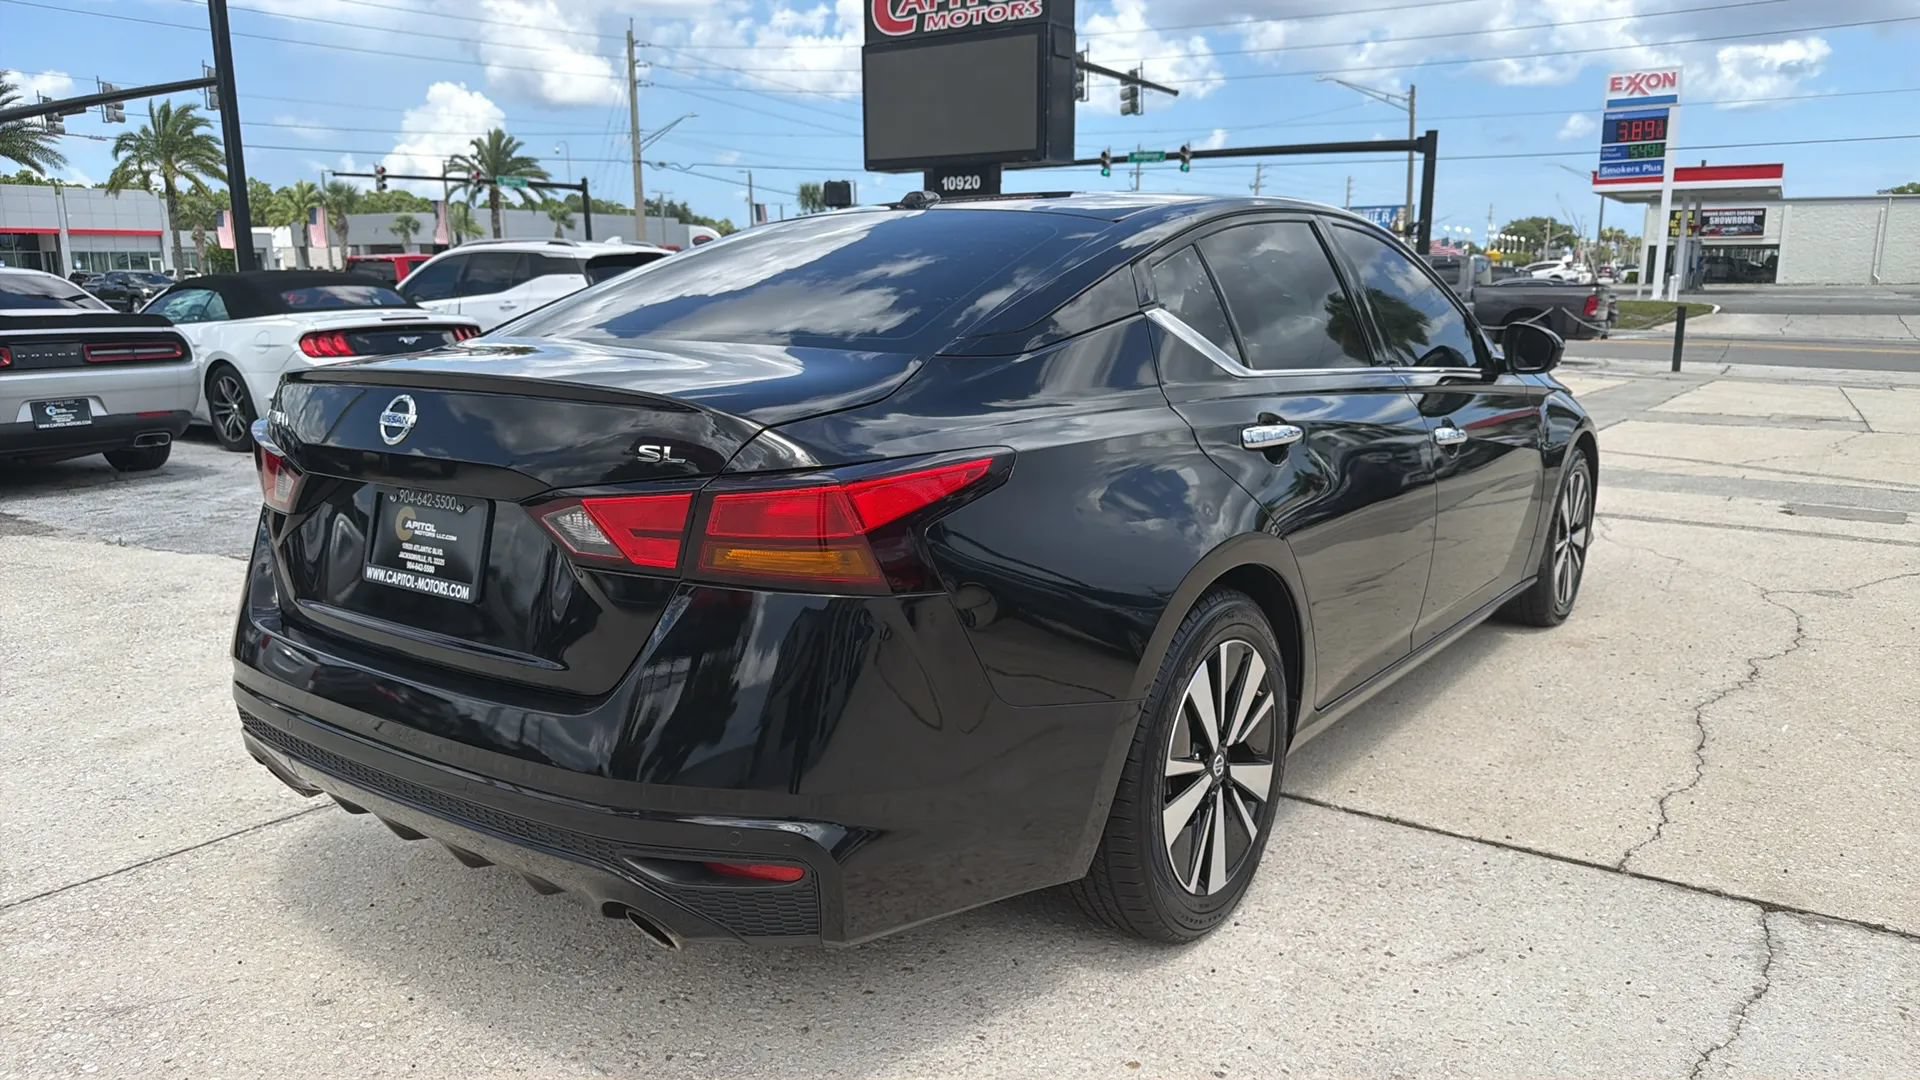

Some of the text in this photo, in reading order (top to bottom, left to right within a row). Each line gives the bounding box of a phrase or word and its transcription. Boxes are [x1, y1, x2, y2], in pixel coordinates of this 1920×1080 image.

[924, 0, 1043, 31] MOTORS
[1610, 72, 1677, 96] EXXON
[1601, 166, 1640, 175] Smokers
[941, 175, 981, 190] 10920
[1709, 216, 1755, 225] SHOWROOM
[382, 414, 410, 425] NISSAN
[637, 445, 687, 463] SL
[399, 489, 457, 511] 904-642-5500
[366, 566, 470, 600] WWW.CAPITOL-MOTORS.COM
